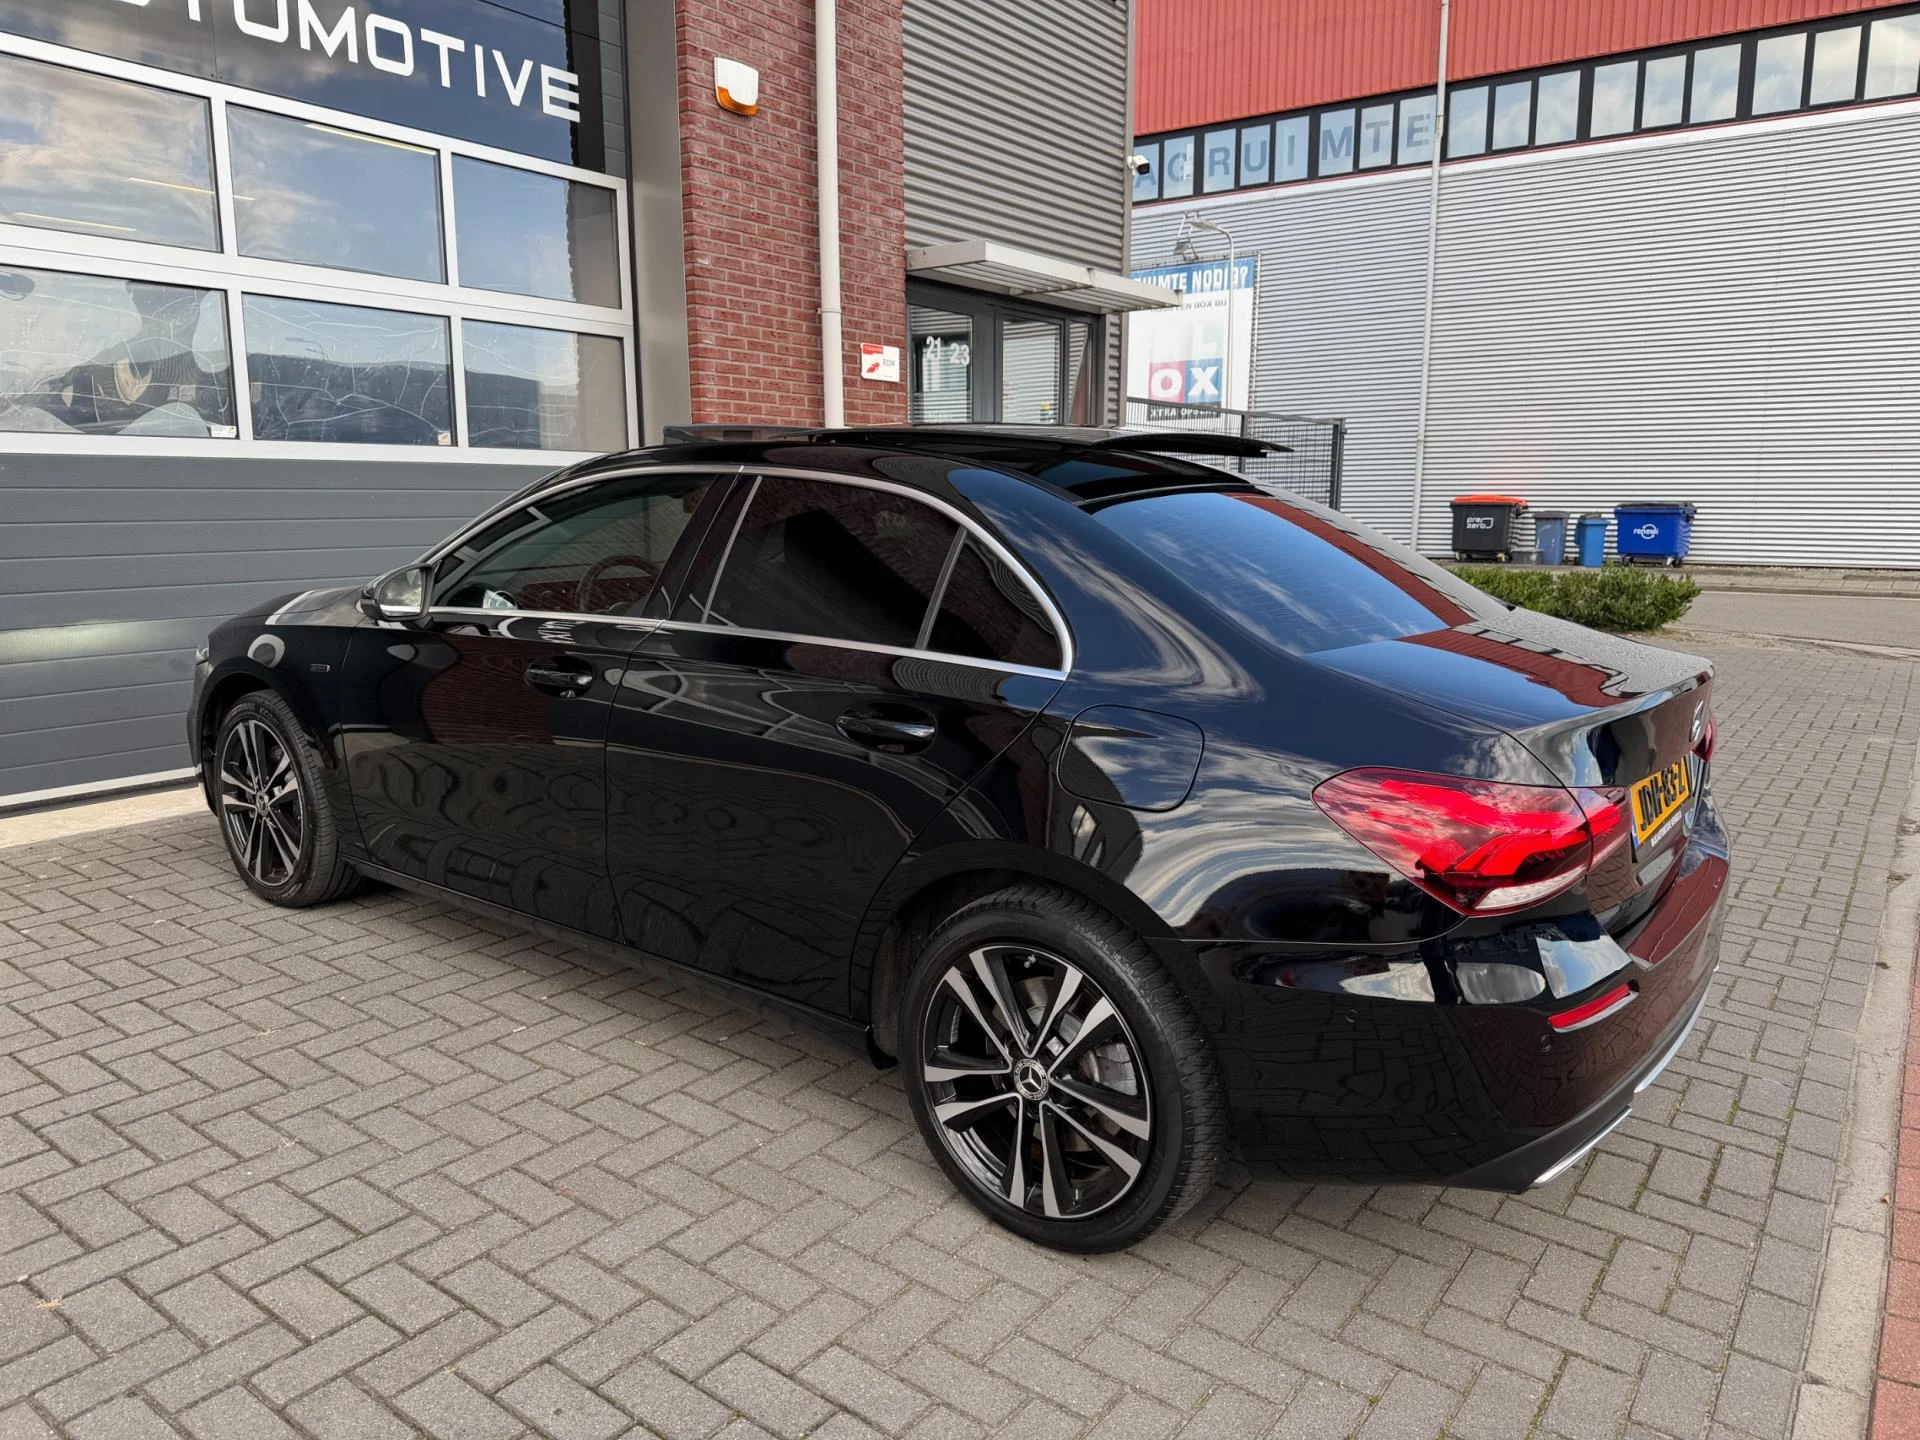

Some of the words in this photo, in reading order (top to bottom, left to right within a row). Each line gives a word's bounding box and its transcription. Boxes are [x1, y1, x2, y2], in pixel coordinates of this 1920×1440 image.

[118, 0, 580, 123] OMOTIVE
[926, 336, 941, 360] 21
[950, 343, 970, 366] 23
[1633, 527, 1659, 537] renewi
